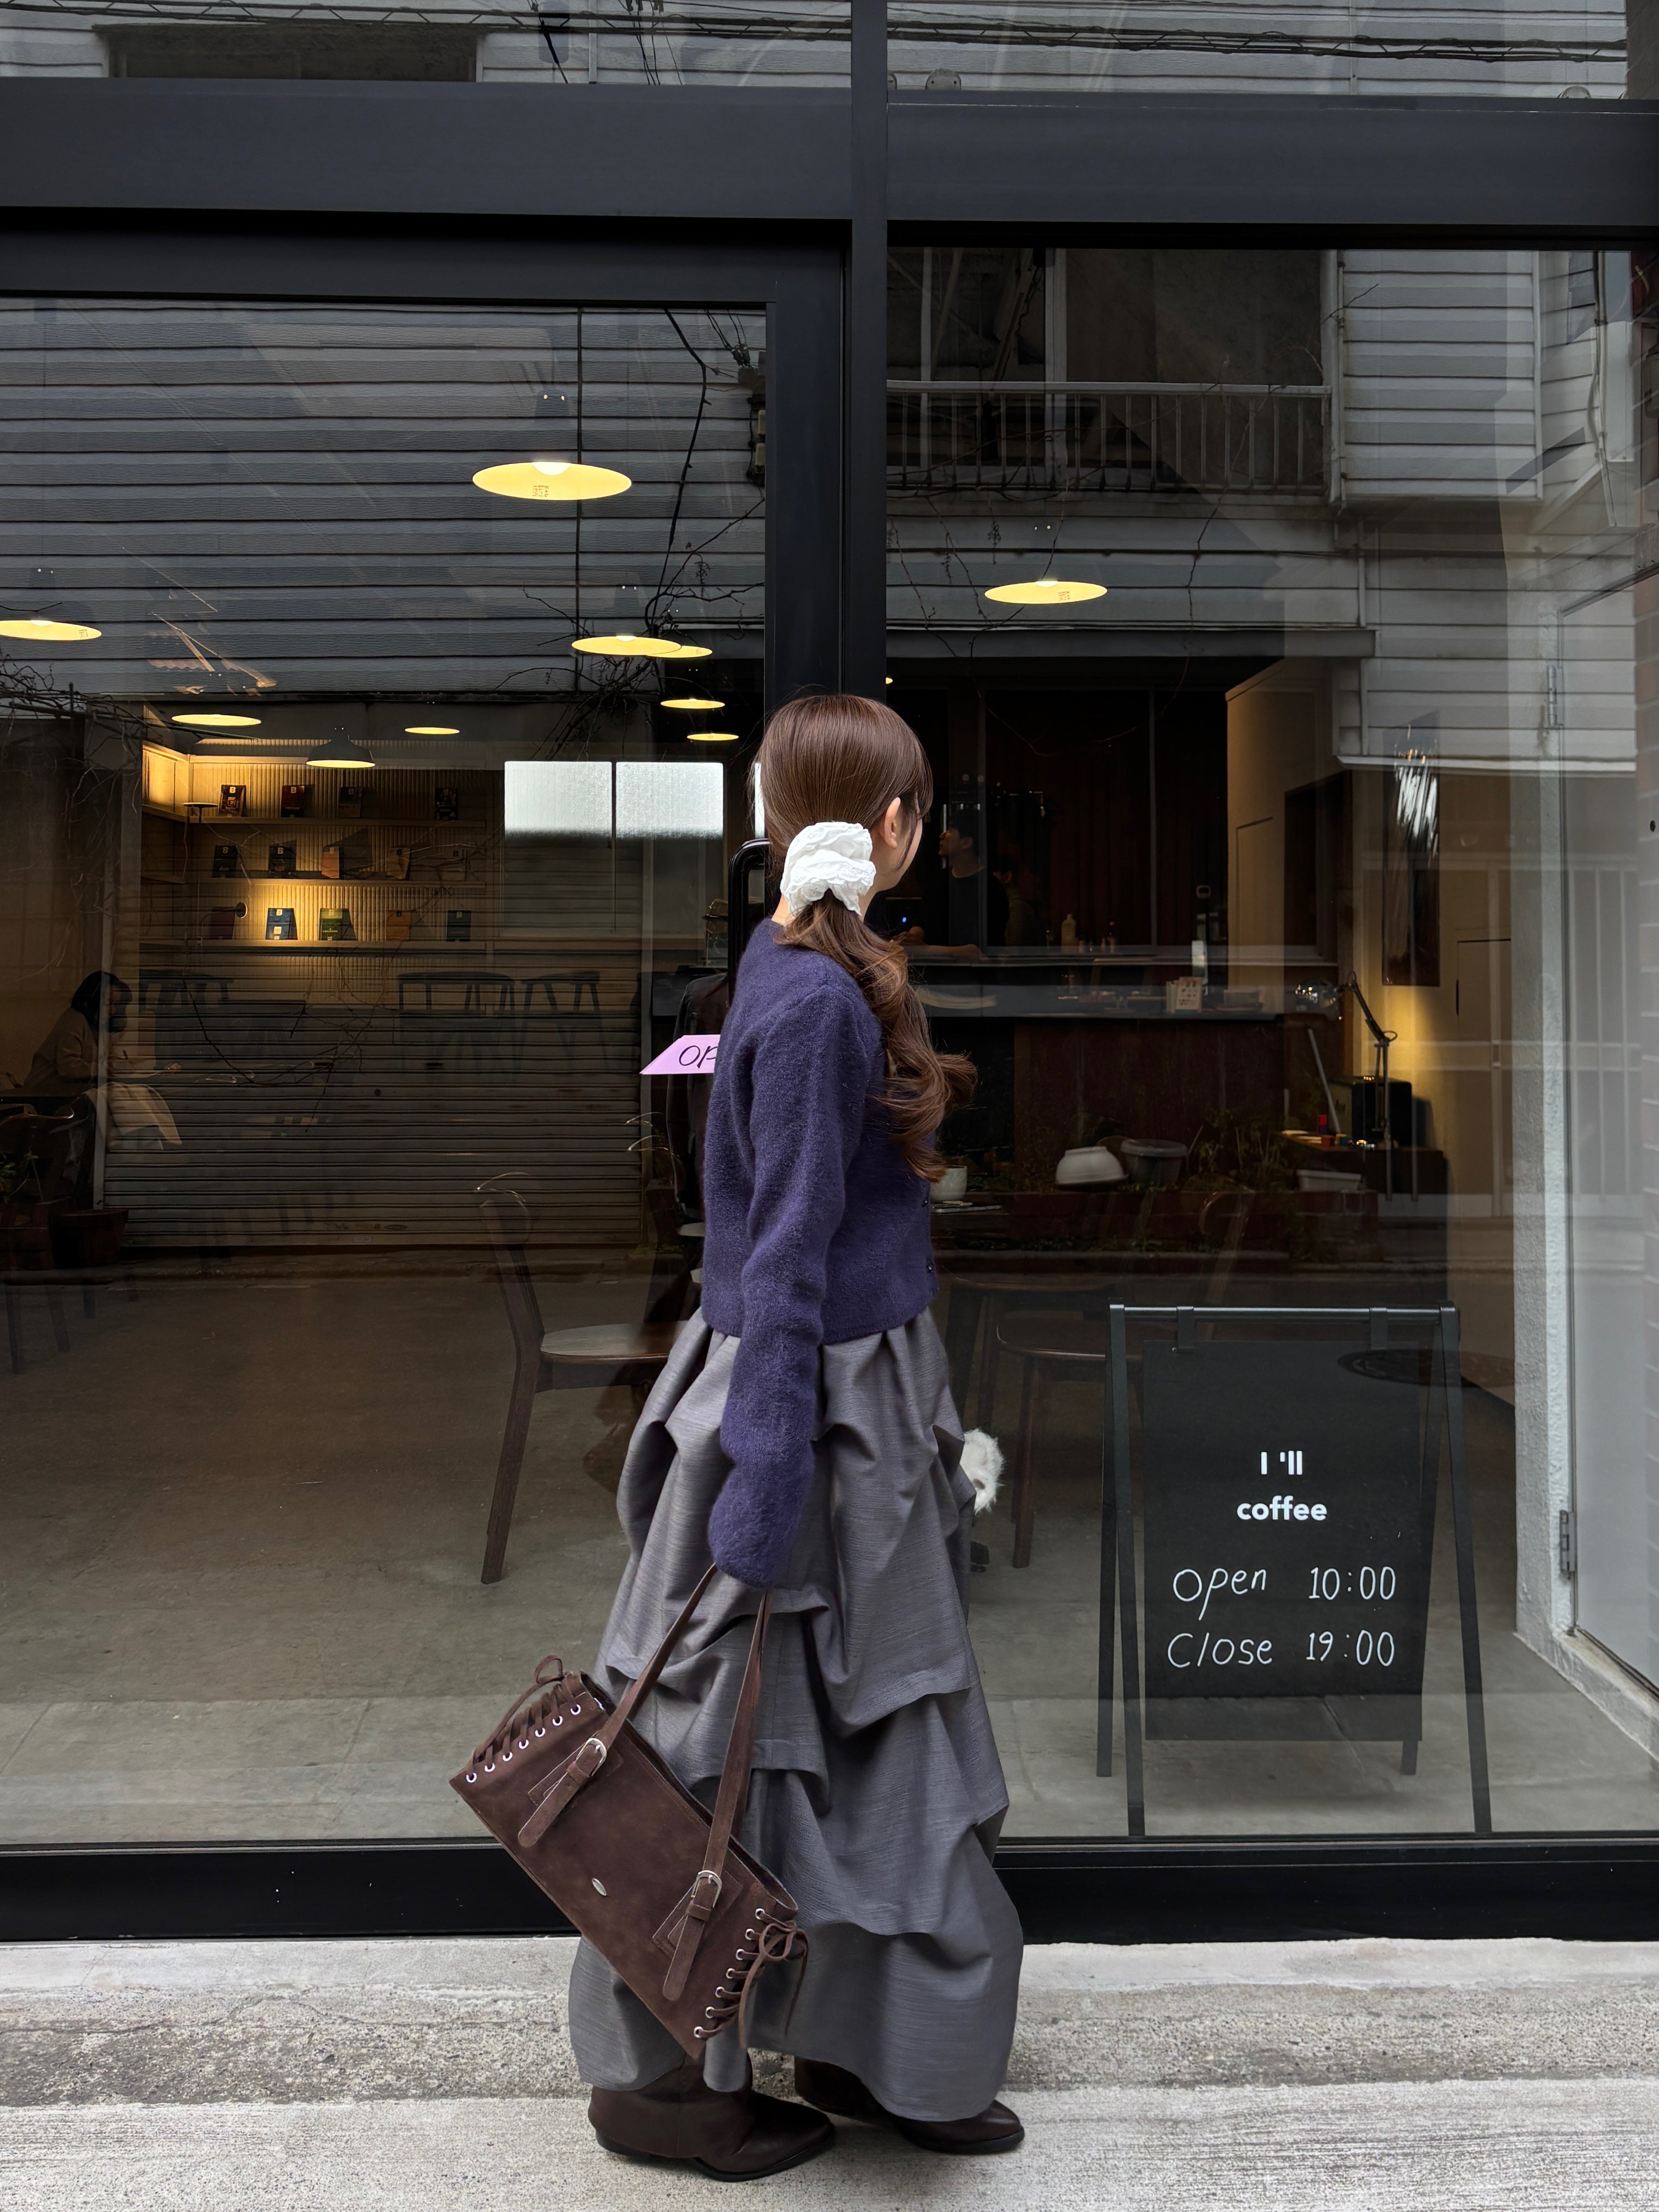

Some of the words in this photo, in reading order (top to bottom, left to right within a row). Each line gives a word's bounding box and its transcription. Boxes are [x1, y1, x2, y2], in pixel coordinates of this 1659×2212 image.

[1237, 1495, 1327, 1521] coffee
[1173, 1568, 1266, 1621] Open
[1308, 1566, 1396, 1600] 10:00
[1168, 1632, 1272, 1668] Close
[1306, 1630, 1394, 1666] 19:00
